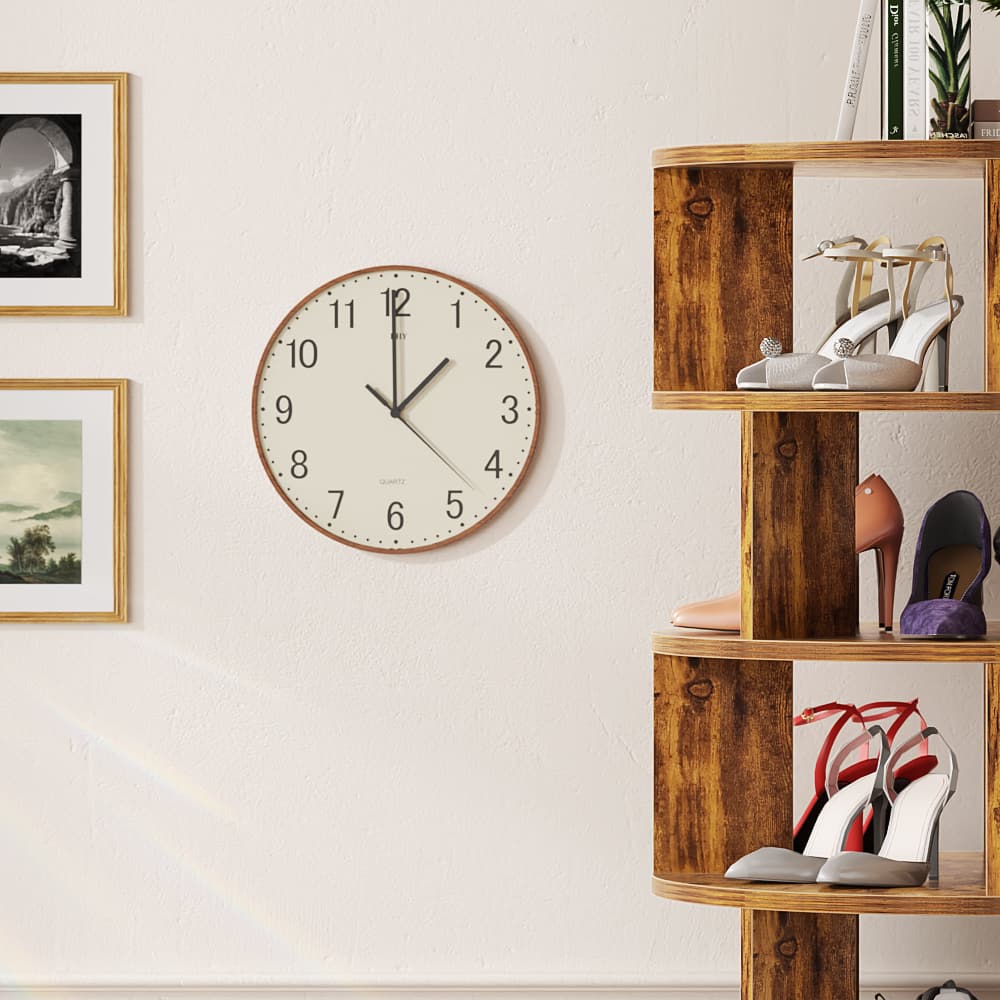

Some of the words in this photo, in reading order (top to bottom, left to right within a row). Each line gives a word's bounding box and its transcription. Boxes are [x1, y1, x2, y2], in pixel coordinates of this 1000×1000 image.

[329, 299, 355, 329] 11
[380, 287, 411, 317] 12
[450, 299, 461, 329] 1
[286, 338, 318, 369] 10
[484, 338, 503, 369] 2
[275, 395, 293, 424] 9
[501, 395, 519, 424] 3
[290, 449, 308, 479] 8
[484, 449, 503, 479] 4
[327, 490, 344, 519] 7
[387, 501, 404, 531] 6
[446, 490, 463, 520] 5
